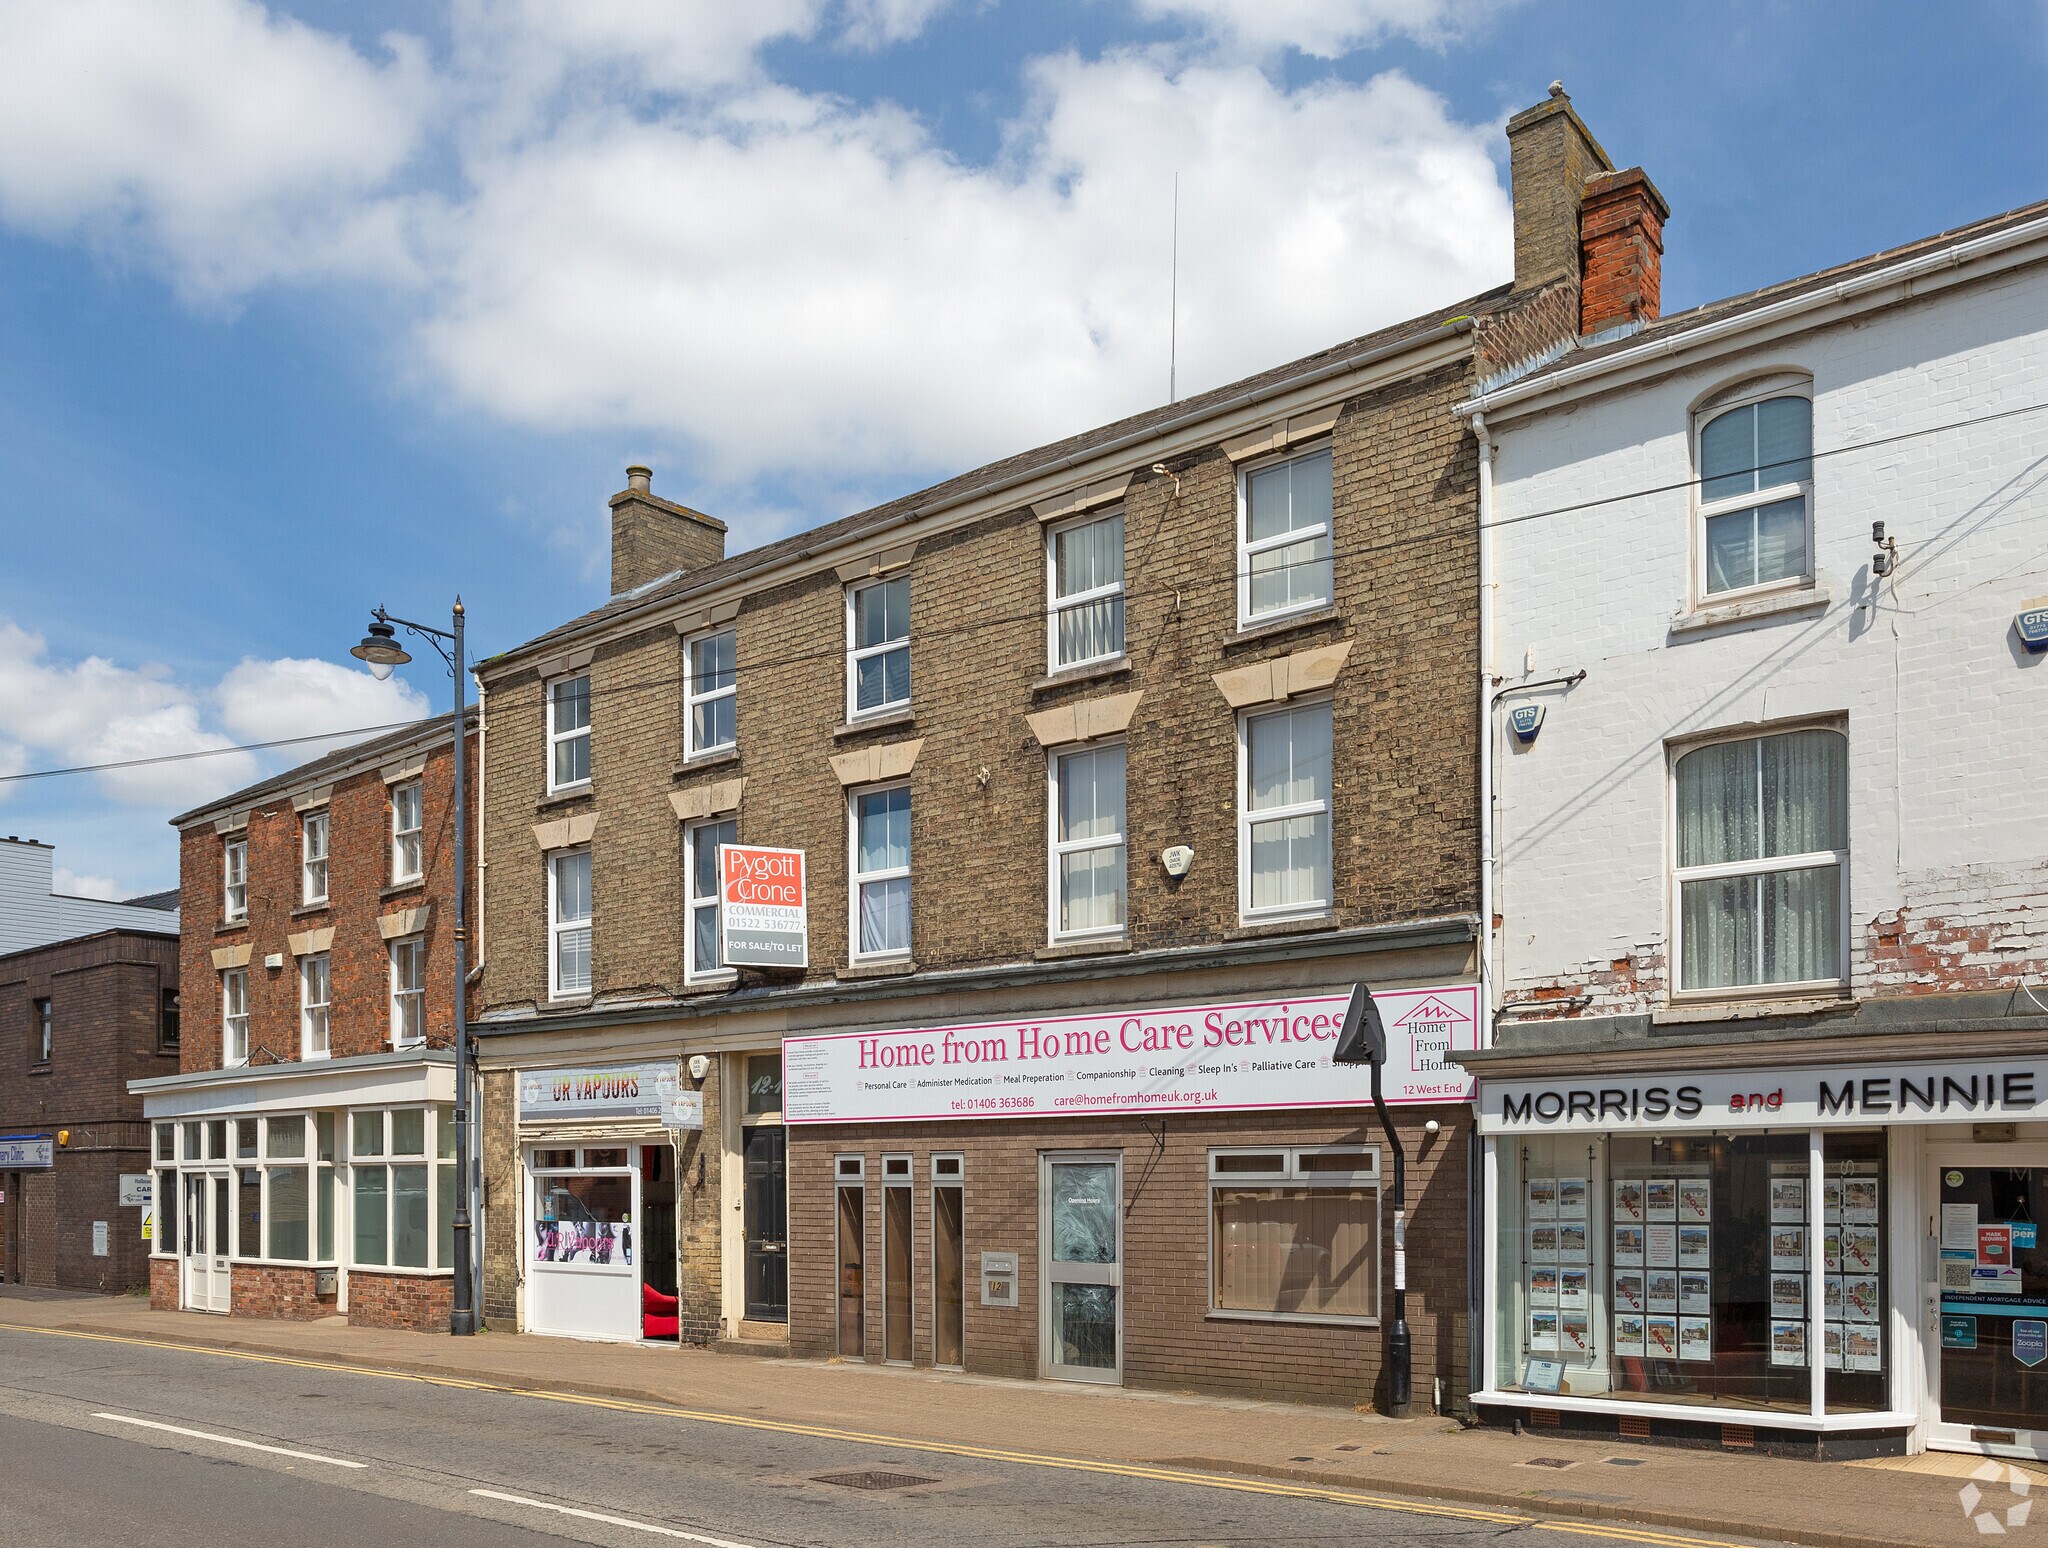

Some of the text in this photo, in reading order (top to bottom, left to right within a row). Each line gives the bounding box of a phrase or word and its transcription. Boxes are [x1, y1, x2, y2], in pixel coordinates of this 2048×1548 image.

[1515, 707, 1536, 719] GTS
[730, 851, 795, 880] Pygott
[737, 879, 796, 902] Crone
[729, 905, 801, 919] COMMERCIAL
[729, 917, 801, 931] 01522 536777
[728, 941, 802, 953] FOR SALE/TO LET
[1408, 1021, 1446, 1034] Home
[858, 1039, 935, 1069] Home
[942, 1031, 1008, 1064] from
[1017, 1027, 1111, 1060] Home
[1119, 1018, 1194, 1051] Care
[1416, 1039, 1450, 1051] From
[1198, 1064, 1221, 1075] Sleep
[1251, 1060, 1316, 1072] Palliative Care
[1420, 1058, 1458, 1071] Home
[1076, 1069, 1136, 1081] Companionship
[1149, 1066, 1185, 1077] Cleaning
[916, 1077, 993, 1088] Administer Medication
[1003, 1073, 1065, 1084] Meal Preperation
[553, 1071, 639, 1102] UR VAPOURS
[864, 1081, 908, 1090] Personal Care
[1403, 1083, 1462, 1094] 12 West End
[1054, 1088, 1218, 1107] care@homefromhomeuk.org.uk
[1503, 1072, 2036, 1120] MORRISS and MENNIE
[951, 1096, 1035, 1110] tel: 01406 363686
[1684, 1193, 1705, 1217] SOLD
[567, 1231, 615, 1252] Vapours
[992, 1281, 1002, 1291] 12
[1944, 1294, 1986, 1302] INDEPENDENT
[2017, 1339, 2043, 1348] Zoopla
